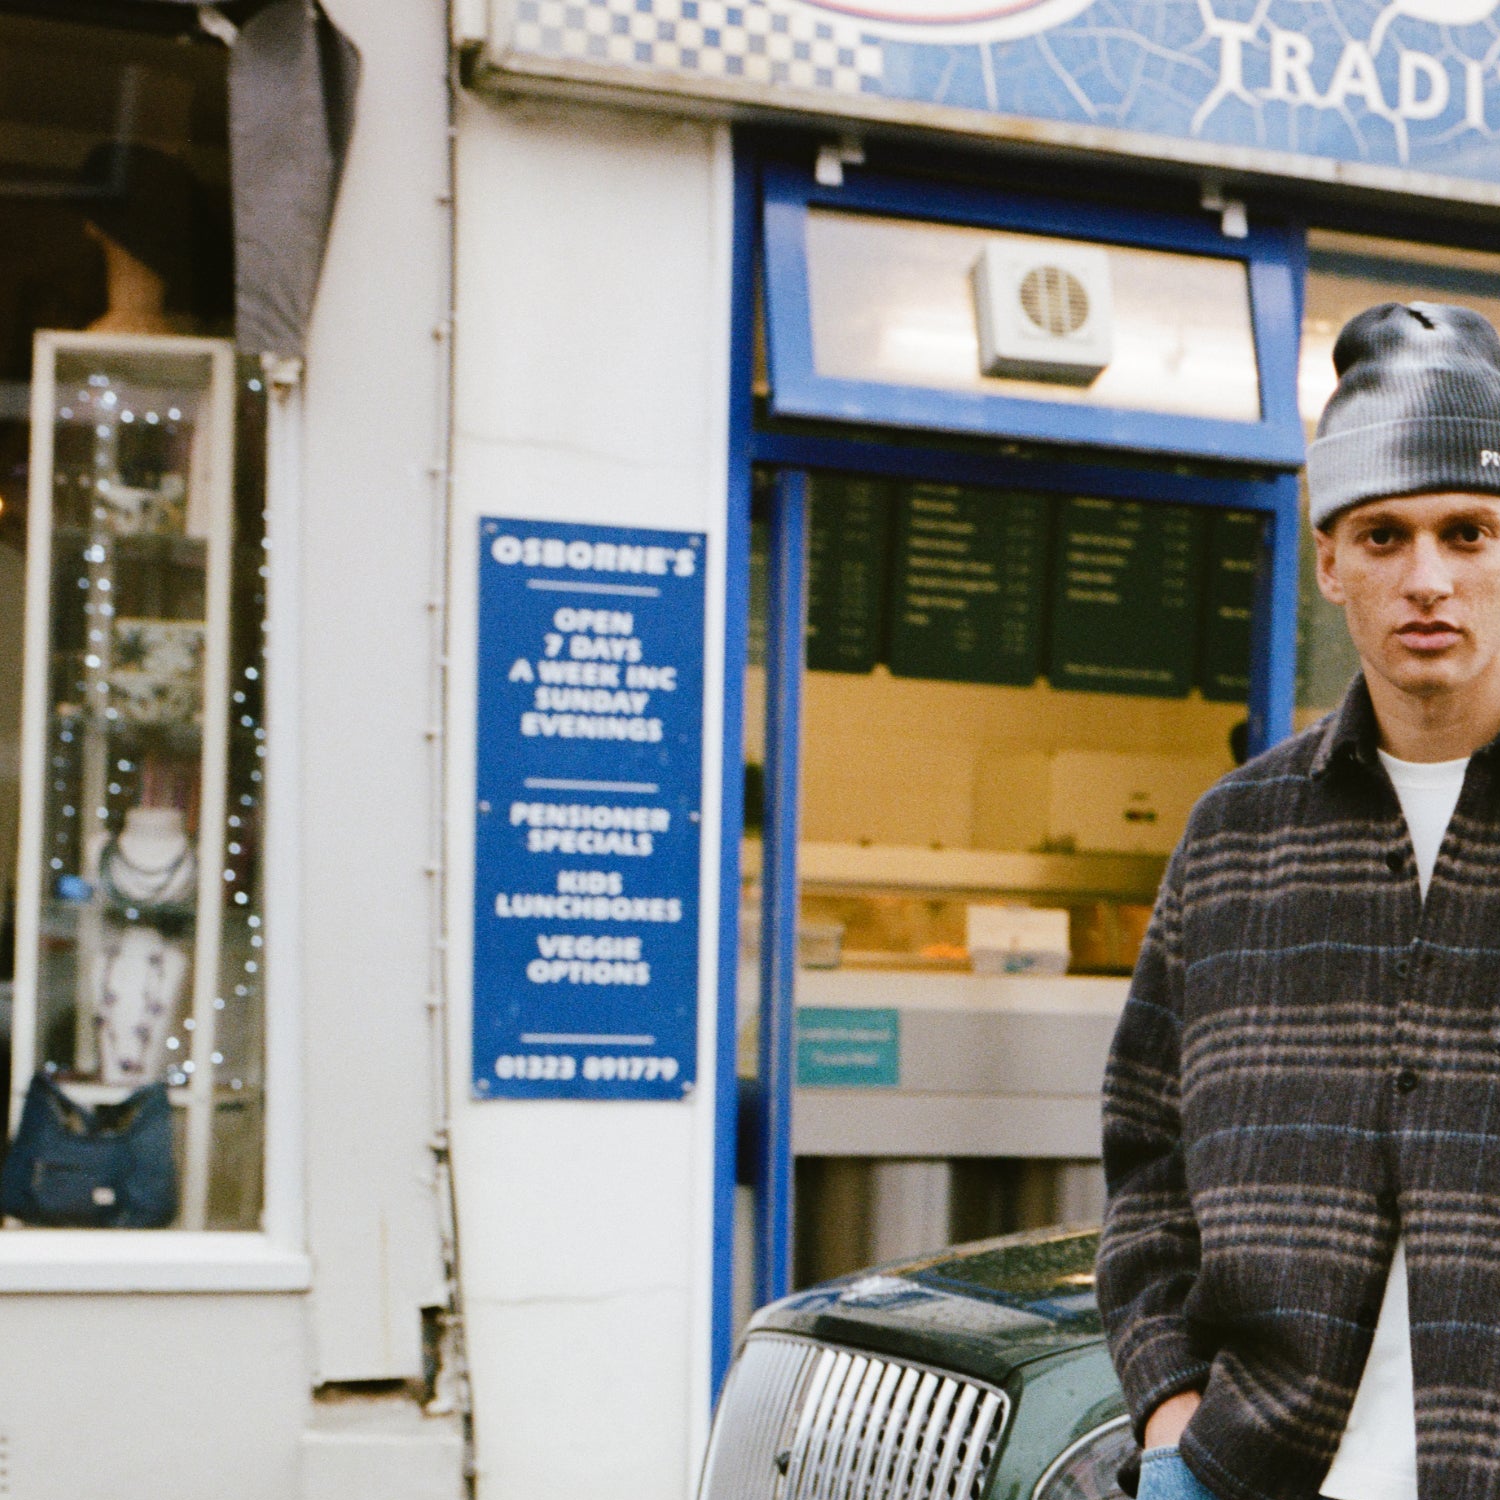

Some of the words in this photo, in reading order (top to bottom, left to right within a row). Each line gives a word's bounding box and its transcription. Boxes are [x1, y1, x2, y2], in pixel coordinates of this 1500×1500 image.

[491, 534, 696, 577] OSBORNE'S
[553, 607, 634, 635] OPEN
[543, 633, 564, 658] 7
[569, 634, 642, 663] DAYS
[508, 658, 535, 683] A
[537, 659, 621, 688] WEEK
[625, 664, 678, 692] INC
[534, 684, 650, 714] SUNDAY
[520, 711, 663, 742] EVENINGS
[509, 802, 671, 832] PENSIONER
[527, 828, 654, 856] SPECIALS
[557, 869, 623, 896] KIDS
[495, 892, 682, 923] LUNCHBOXES
[536, 934, 643, 961] VEGGIE
[526, 958, 651, 986] OPTIONS
